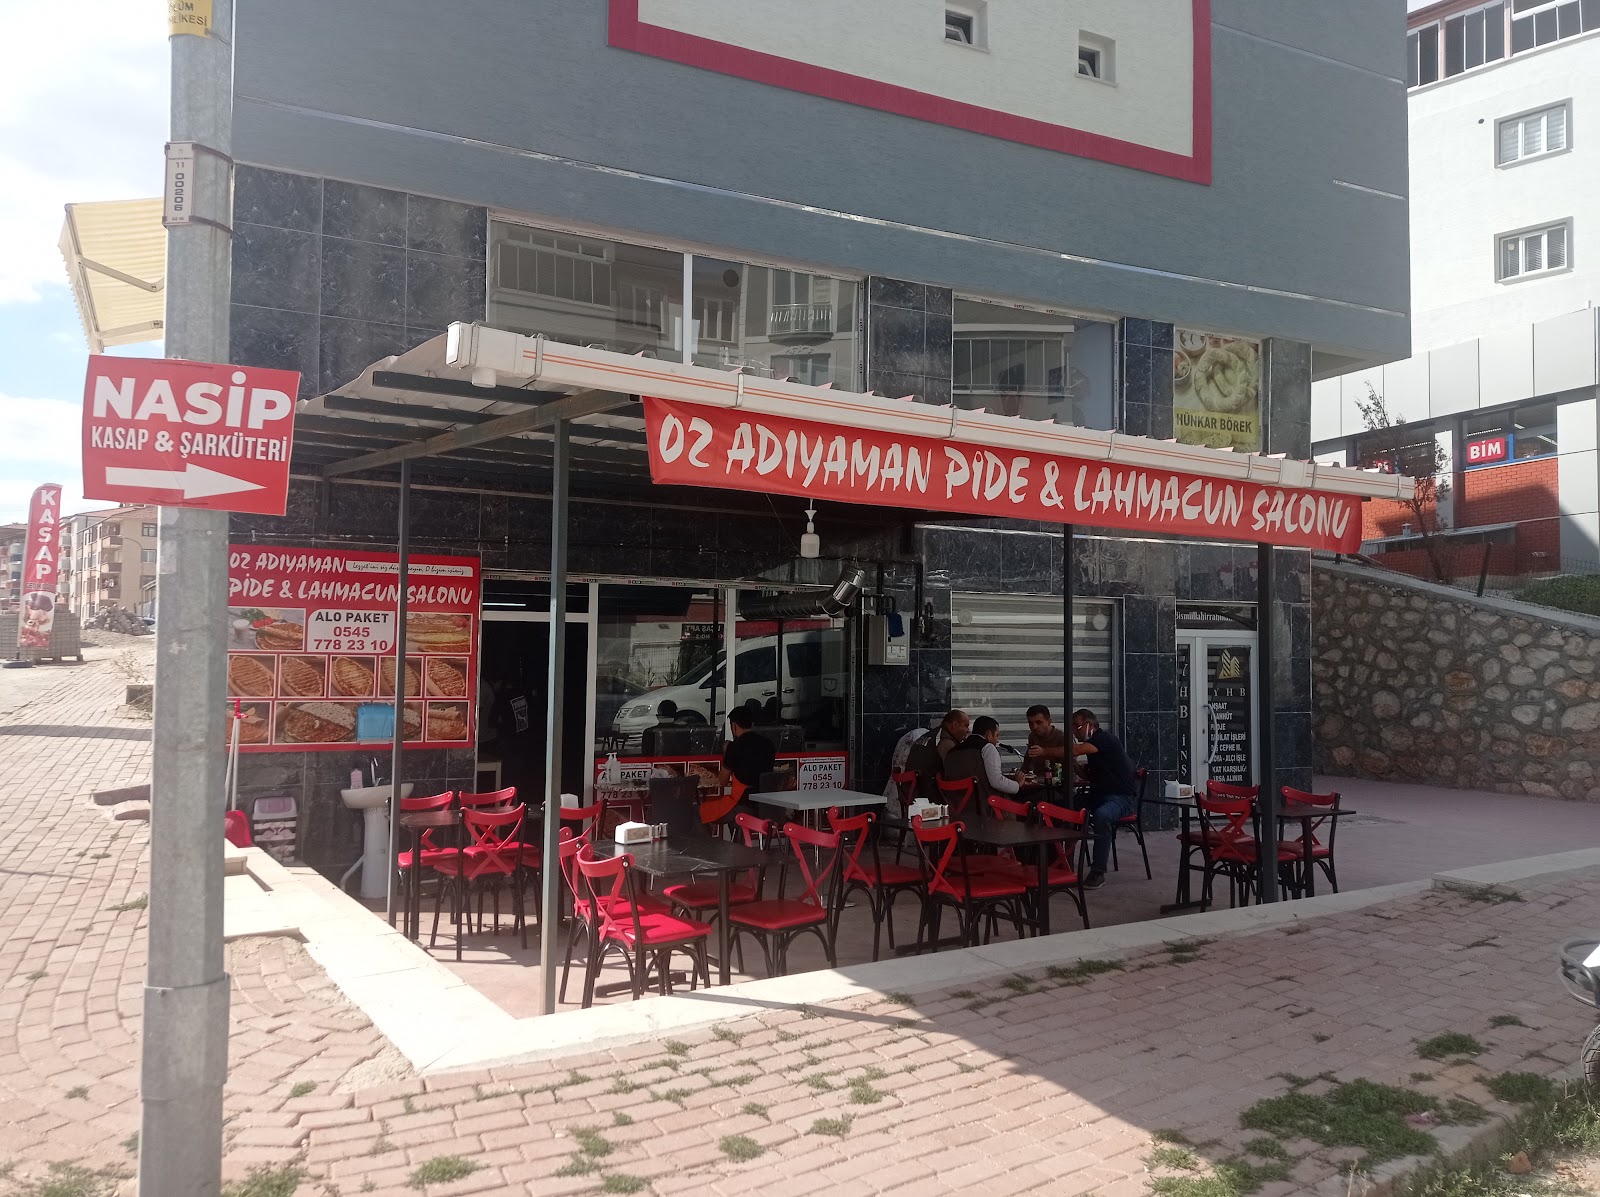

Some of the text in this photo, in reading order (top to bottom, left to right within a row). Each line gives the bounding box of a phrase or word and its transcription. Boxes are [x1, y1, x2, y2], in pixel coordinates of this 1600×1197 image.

[174, 173, 185, 211] 00206
[93, 371, 292, 429] NASİP
[1176, 412, 1217, 430] HÜNKAR
[1220, 417, 1252, 434] BÖREK
[91, 425, 288, 462] KASAP & ŞARKÜTERİ
[1470, 440, 1501, 460] BİM
[725, 422, 932, 493] ADIYAMAN
[1040, 461, 1064, 510] &
[1073, 465, 1244, 527] LAHMACUN
[1251, 490, 1350, 539] SALONU
[34, 489, 57, 580] KASAP
[255, 553, 346, 573] ADIYAMAN
[229, 573, 473, 605] PİDE & LAHMACUN SALONU
[315, 612, 389, 624] ALO PAKET
[333, 626, 370, 638] 0545
[314, 639, 388, 651] 778 23 10
[620, 771, 647, 779] PAKET
[601, 791, 618, 799] 778
